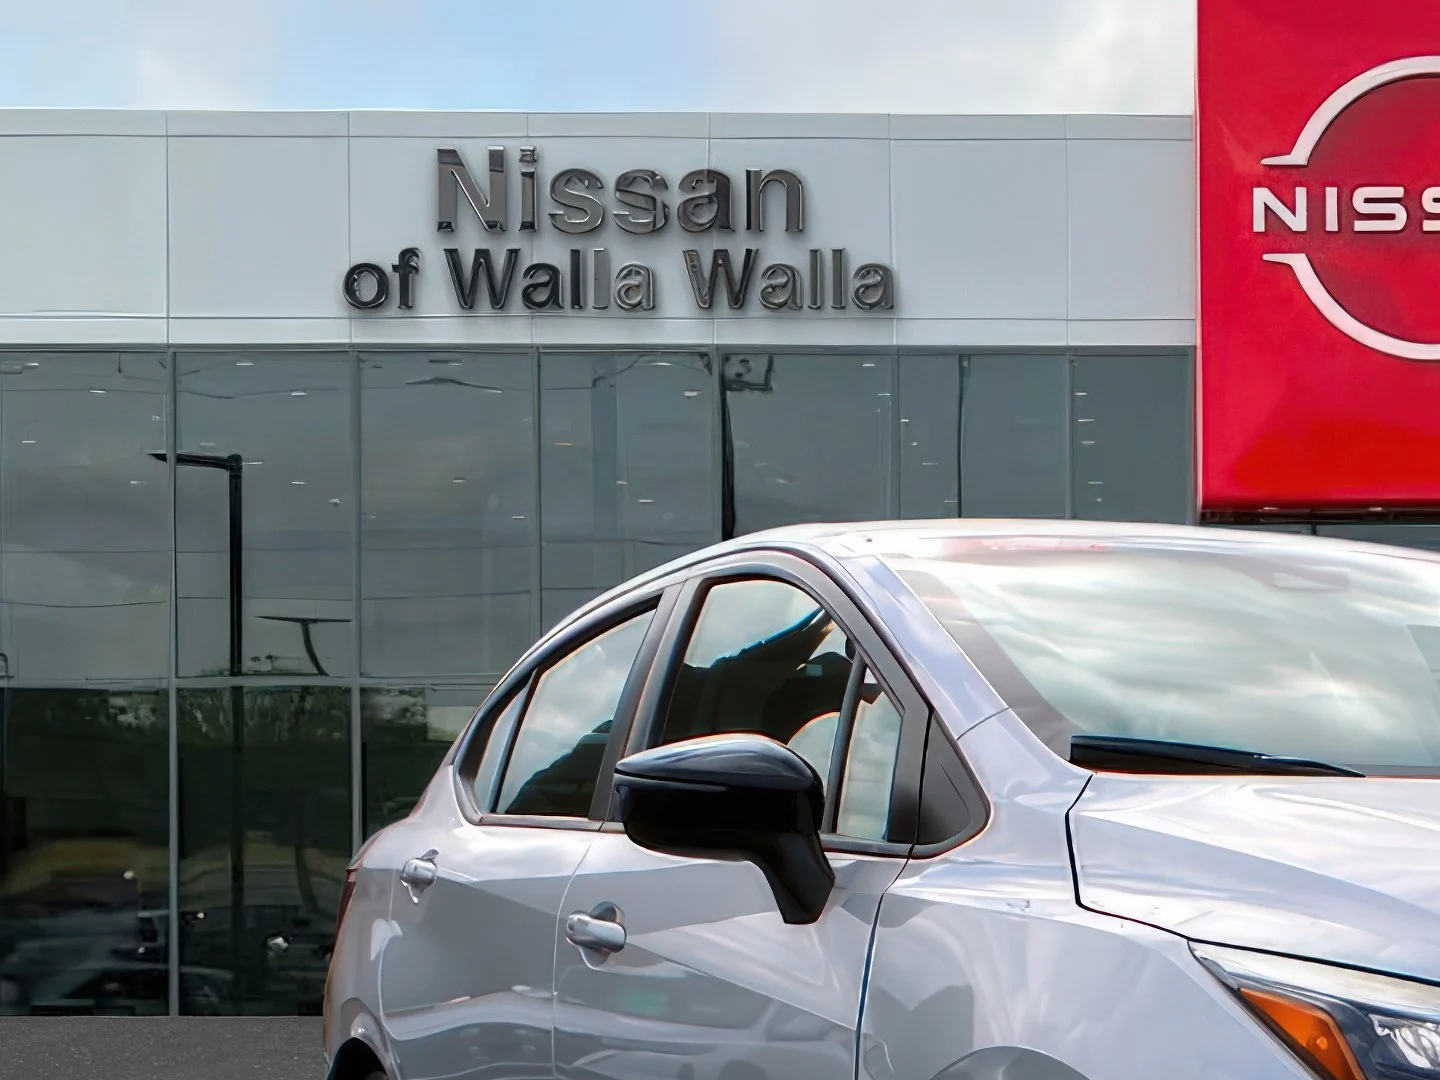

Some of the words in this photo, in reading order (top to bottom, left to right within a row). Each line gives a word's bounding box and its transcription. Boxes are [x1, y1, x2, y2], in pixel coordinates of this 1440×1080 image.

[435, 144, 804, 234] Nissan
[342, 247, 424, 310] of
[443, 247, 657, 311] Walla
[682, 247, 897, 311] Walla
